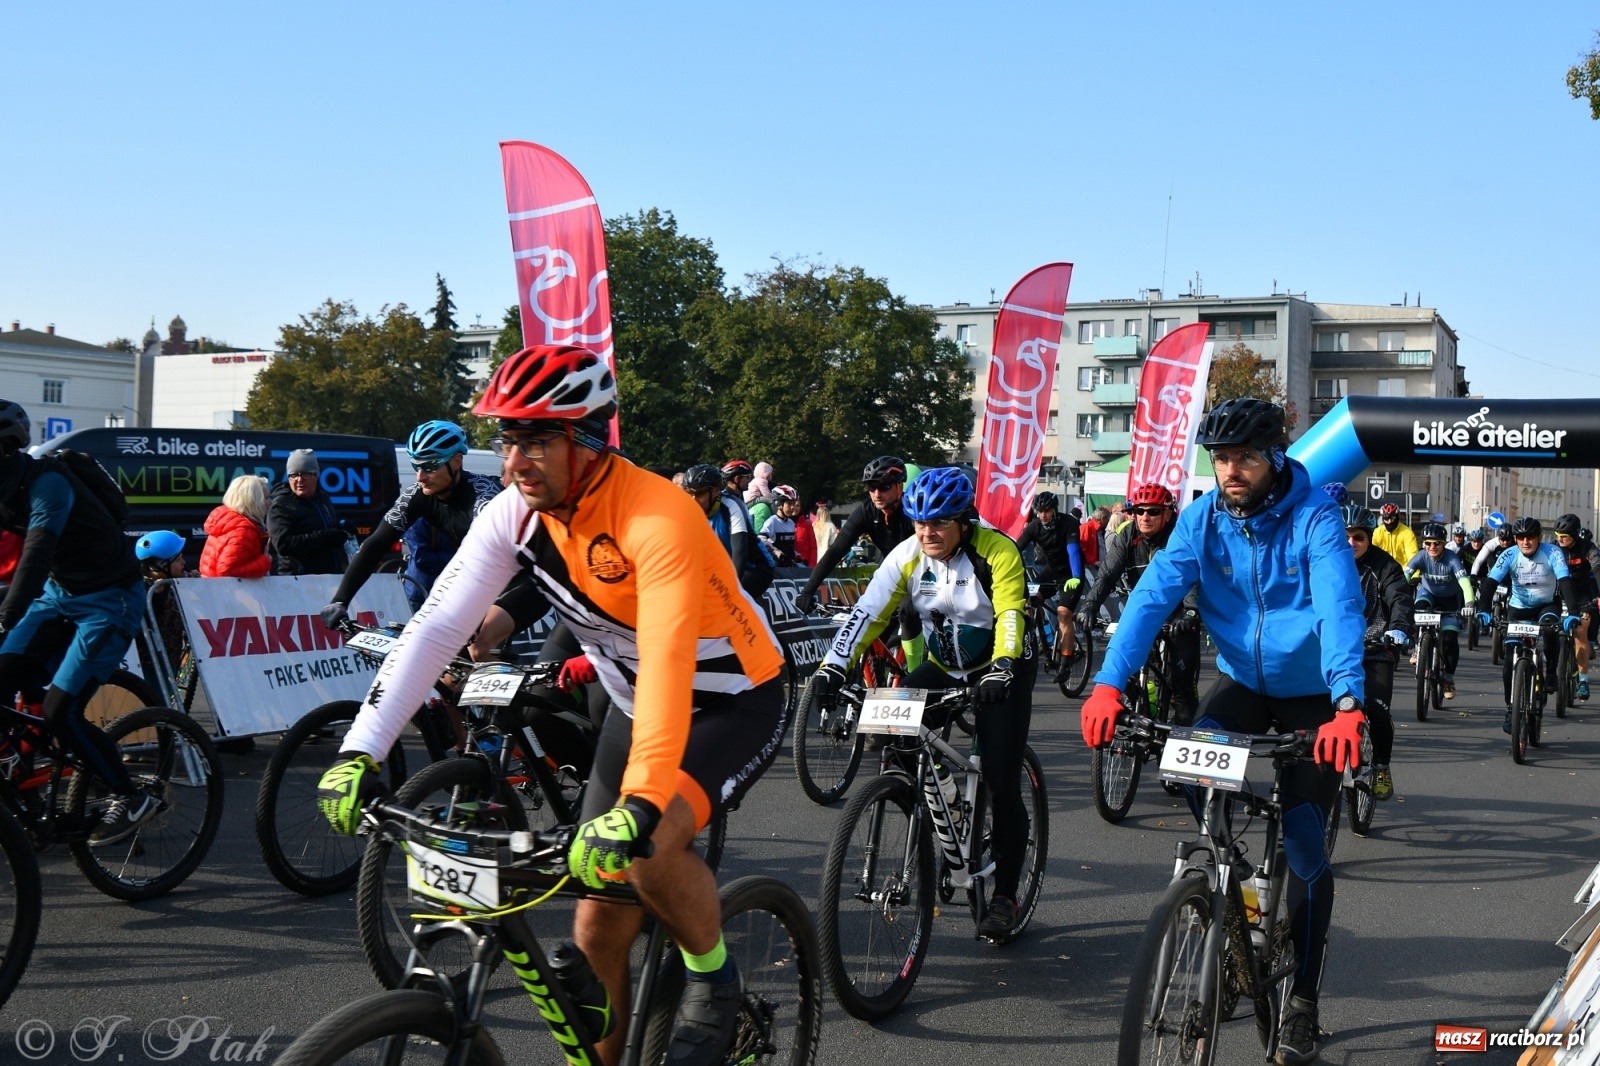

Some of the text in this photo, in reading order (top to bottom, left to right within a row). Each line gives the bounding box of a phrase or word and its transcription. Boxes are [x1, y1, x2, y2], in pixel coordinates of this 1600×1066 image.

[1413, 420, 1567, 449] bike atelier
[157, 437, 266, 457] bike atelier
[358, 635, 391, 648] 3237
[263, 663, 308, 690] TAKE
[307, 654, 354, 682] MORE
[472, 679, 511, 693] 2494
[871, 705, 912, 720] 1844
[1175, 746, 1231, 770] 3198
[420, 861, 477, 895] 1287
